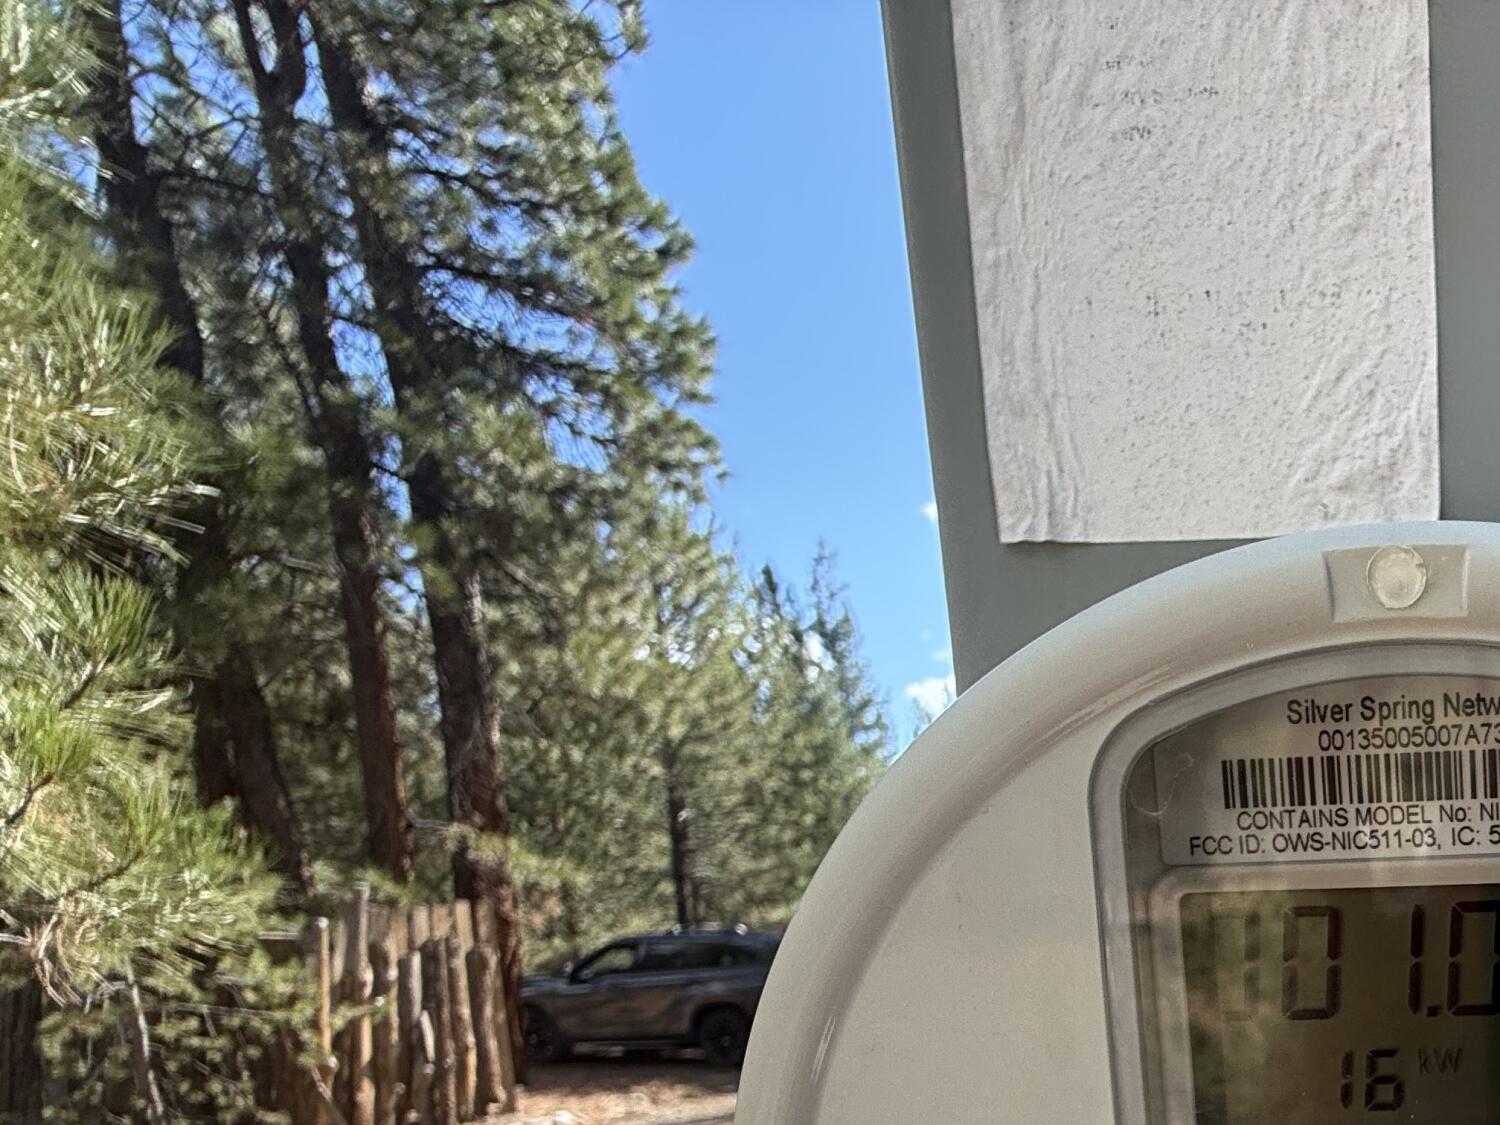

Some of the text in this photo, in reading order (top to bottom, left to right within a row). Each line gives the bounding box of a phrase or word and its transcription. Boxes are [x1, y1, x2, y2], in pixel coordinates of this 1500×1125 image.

[1287, 698, 1353, 725] Silver
[1360, 694, 1435, 726] Spring
[1236, 807, 1349, 831] CONTAINS
[1355, 804, 1433, 827] MODEL
[1440, 804, 1472, 823] No:
[1189, 835, 1233, 856] FCC
[1239, 833, 1266, 855] ID:
[1272, 827, 1442, 853] OWS-NIC511-03,
[1452, 826, 1481, 846] IC:
[1339, 1047, 1464, 1112] 16 kW
